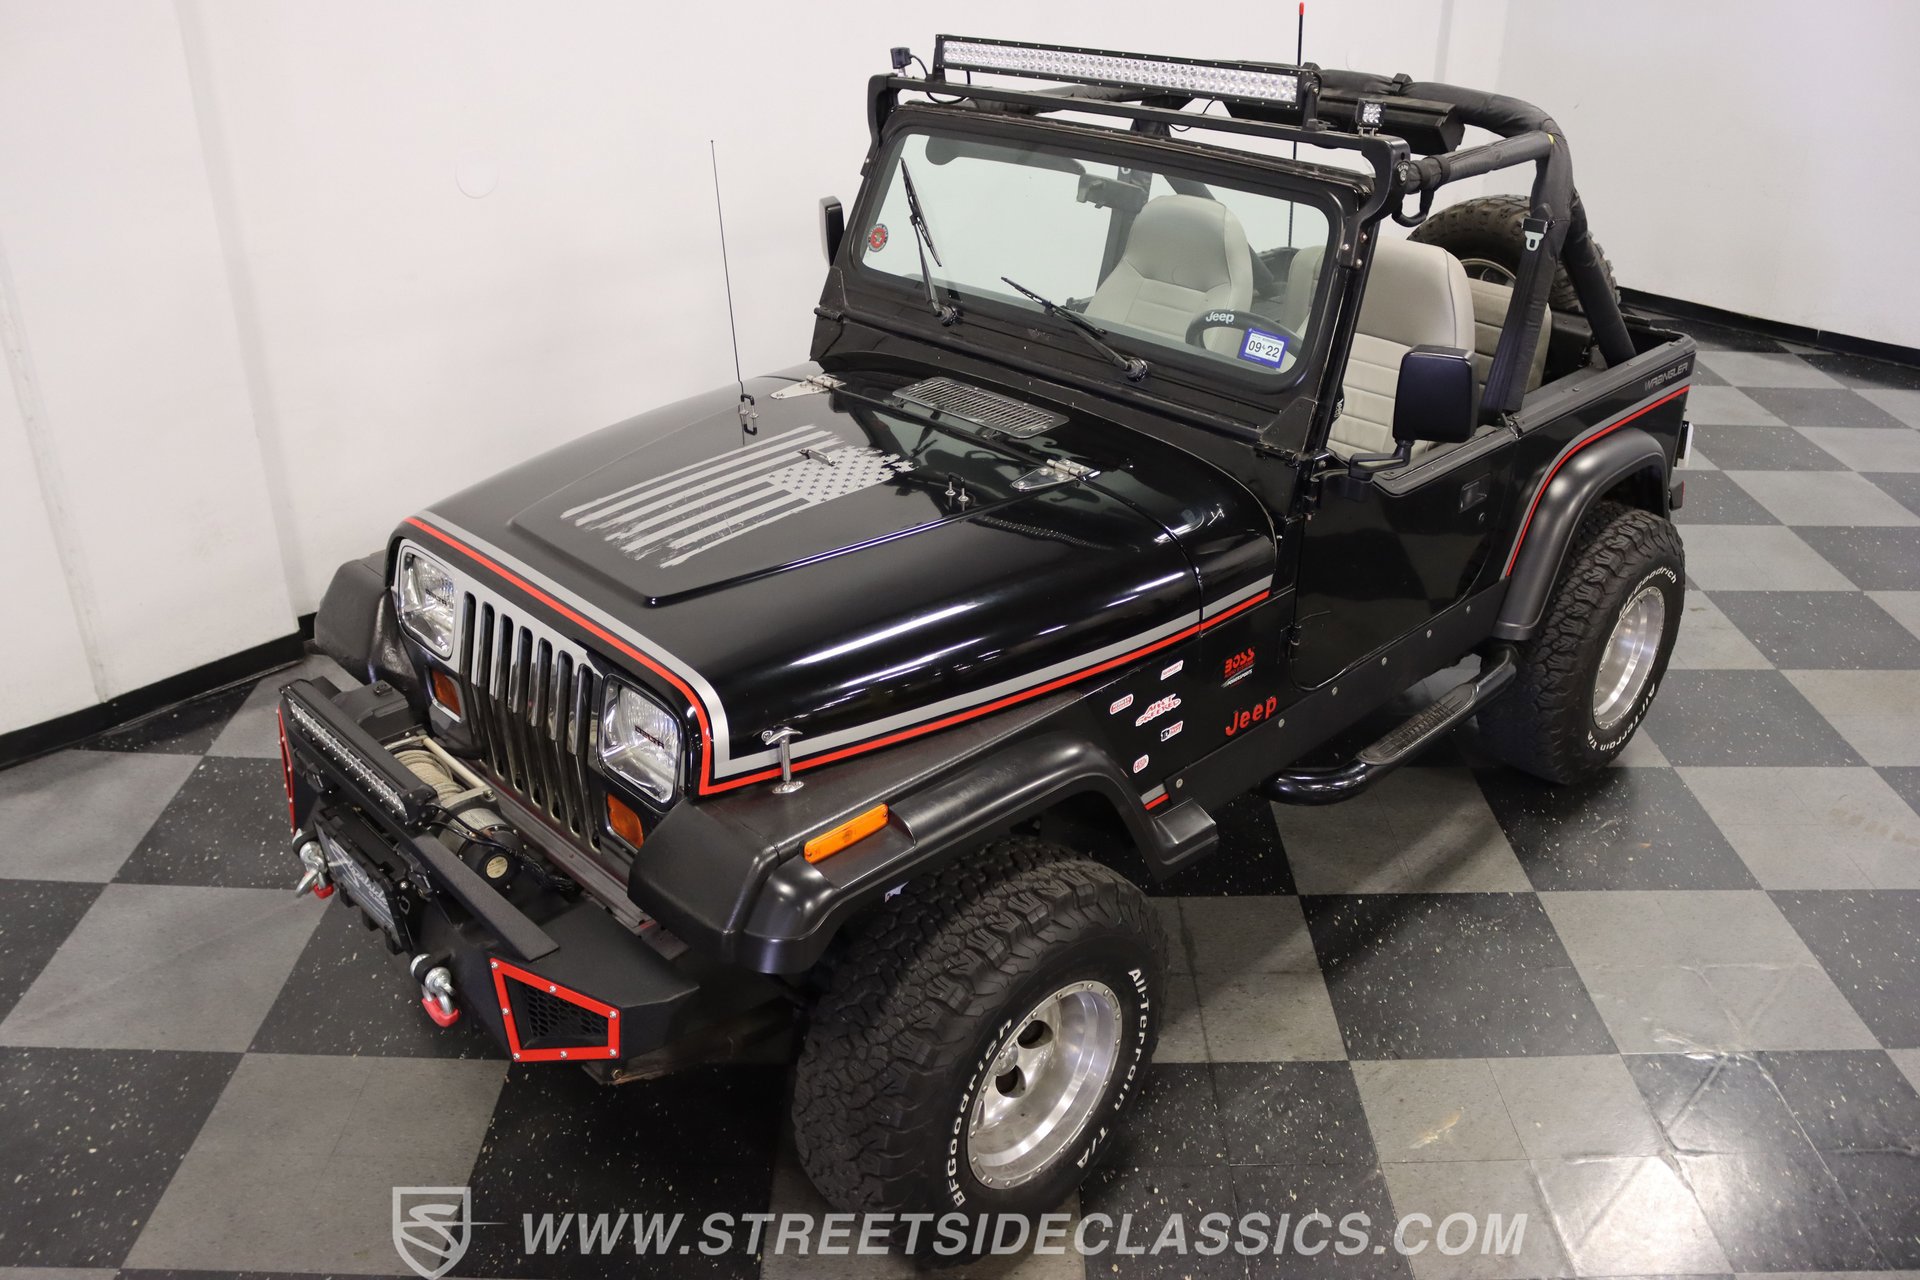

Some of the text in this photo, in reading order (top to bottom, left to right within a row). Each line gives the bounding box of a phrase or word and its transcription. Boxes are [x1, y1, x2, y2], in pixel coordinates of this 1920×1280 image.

[1205, 311, 1235, 325] Jeep
[1248, 340, 1262, 353] 09
[1265, 345, 1280, 358] 22
[1644, 362, 1689, 391] WRANGLER
[1224, 647, 1256, 674] BOSS
[1224, 696, 1277, 736] Jeep
[1076, 968, 1150, 1168] All-Terrain T/A
[947, 1019, 1012, 1207] BFGoodrich
